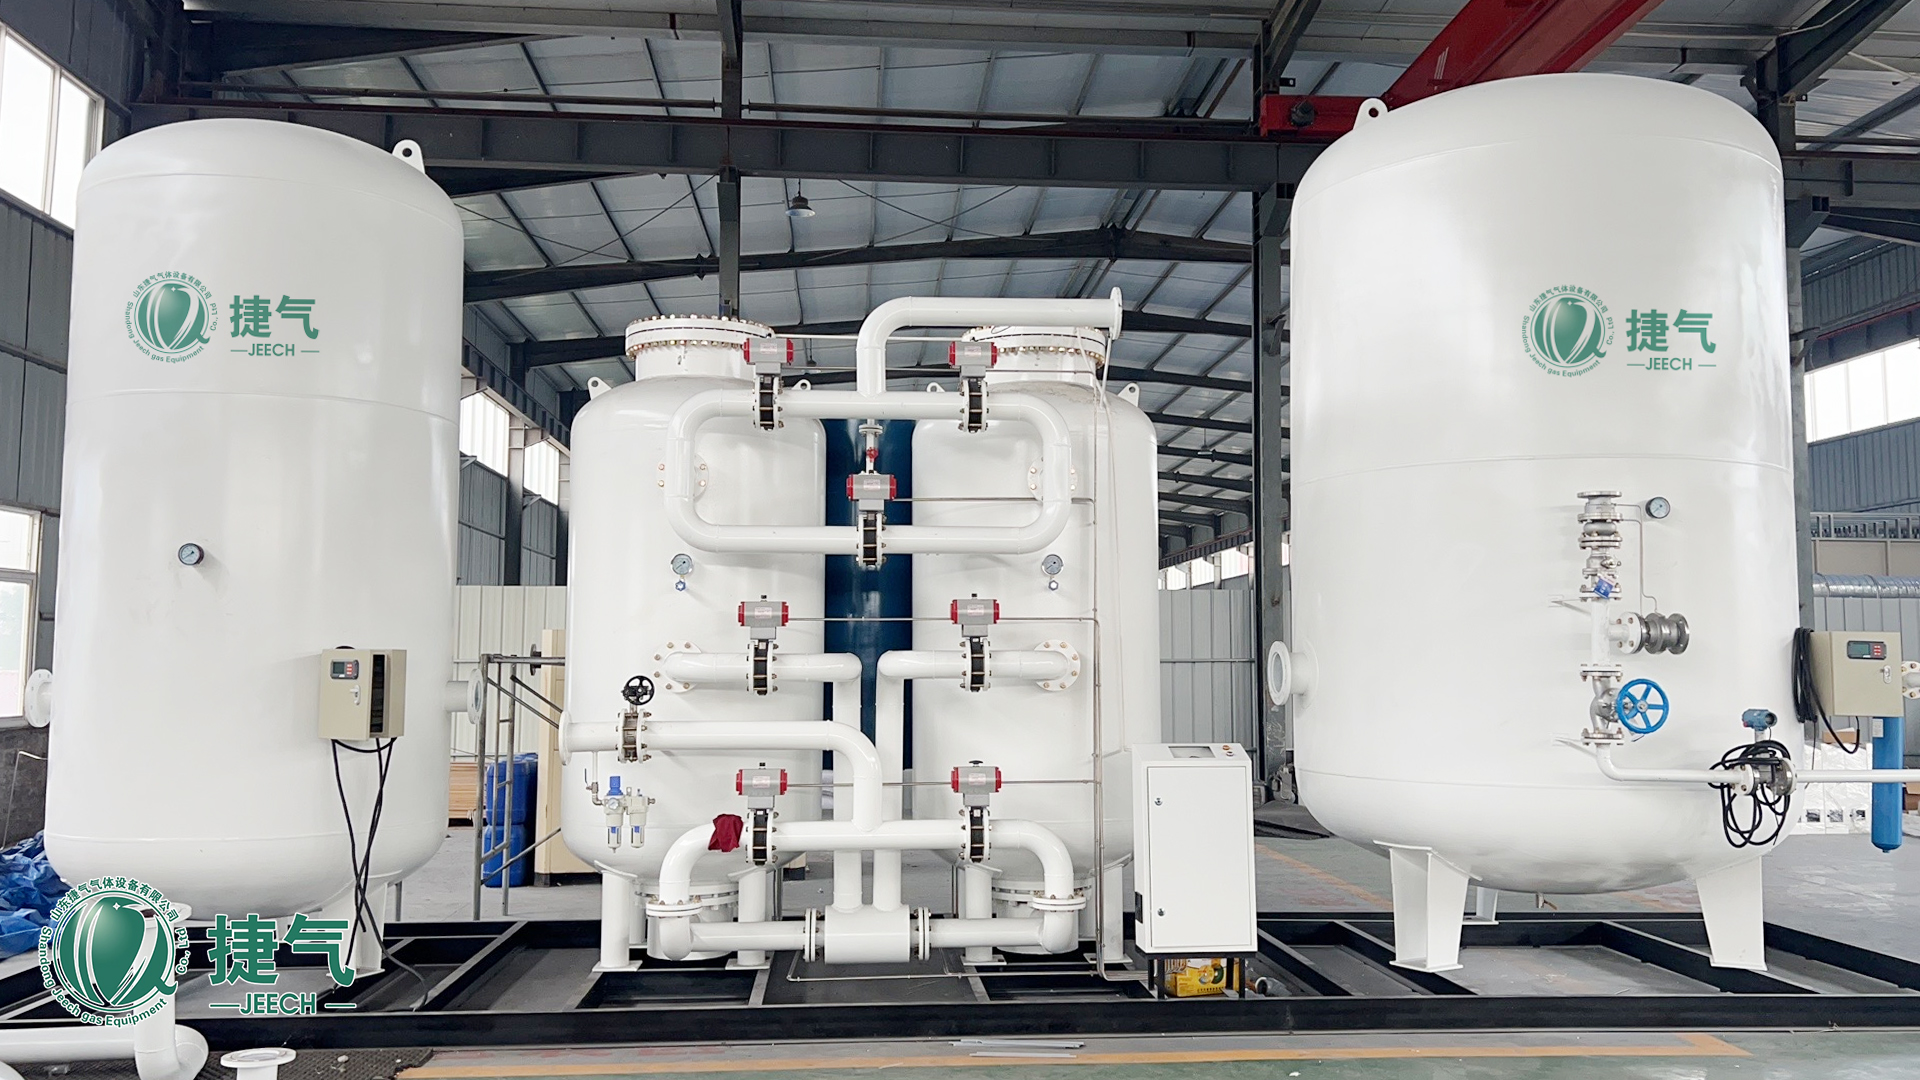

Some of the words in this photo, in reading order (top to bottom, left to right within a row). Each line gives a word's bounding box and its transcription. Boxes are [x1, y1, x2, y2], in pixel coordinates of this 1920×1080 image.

[133, 271, 212, 299] 山东捷气气体设备有限公司
[1529, 285, 1608, 313] 山东捷气气体设备有限公司
[125, 301, 135, 338] Shandong
[133, 339, 151, 356] Jeech
[151, 354, 164, 362] gas
[166, 345, 204, 363] Equipment
[230, 295, 320, 339] 捷气
[1626, 309, 1716, 353] 捷气
[248, 343, 295, 356] JEECH
[1522, 315, 1531, 353] Shandong
[1529, 353, 1547, 371] Jeech
[1547, 367, 1560, 376] gas
[1562, 360, 1600, 377] Equipment
[1645, 358, 1692, 371] JEECH
